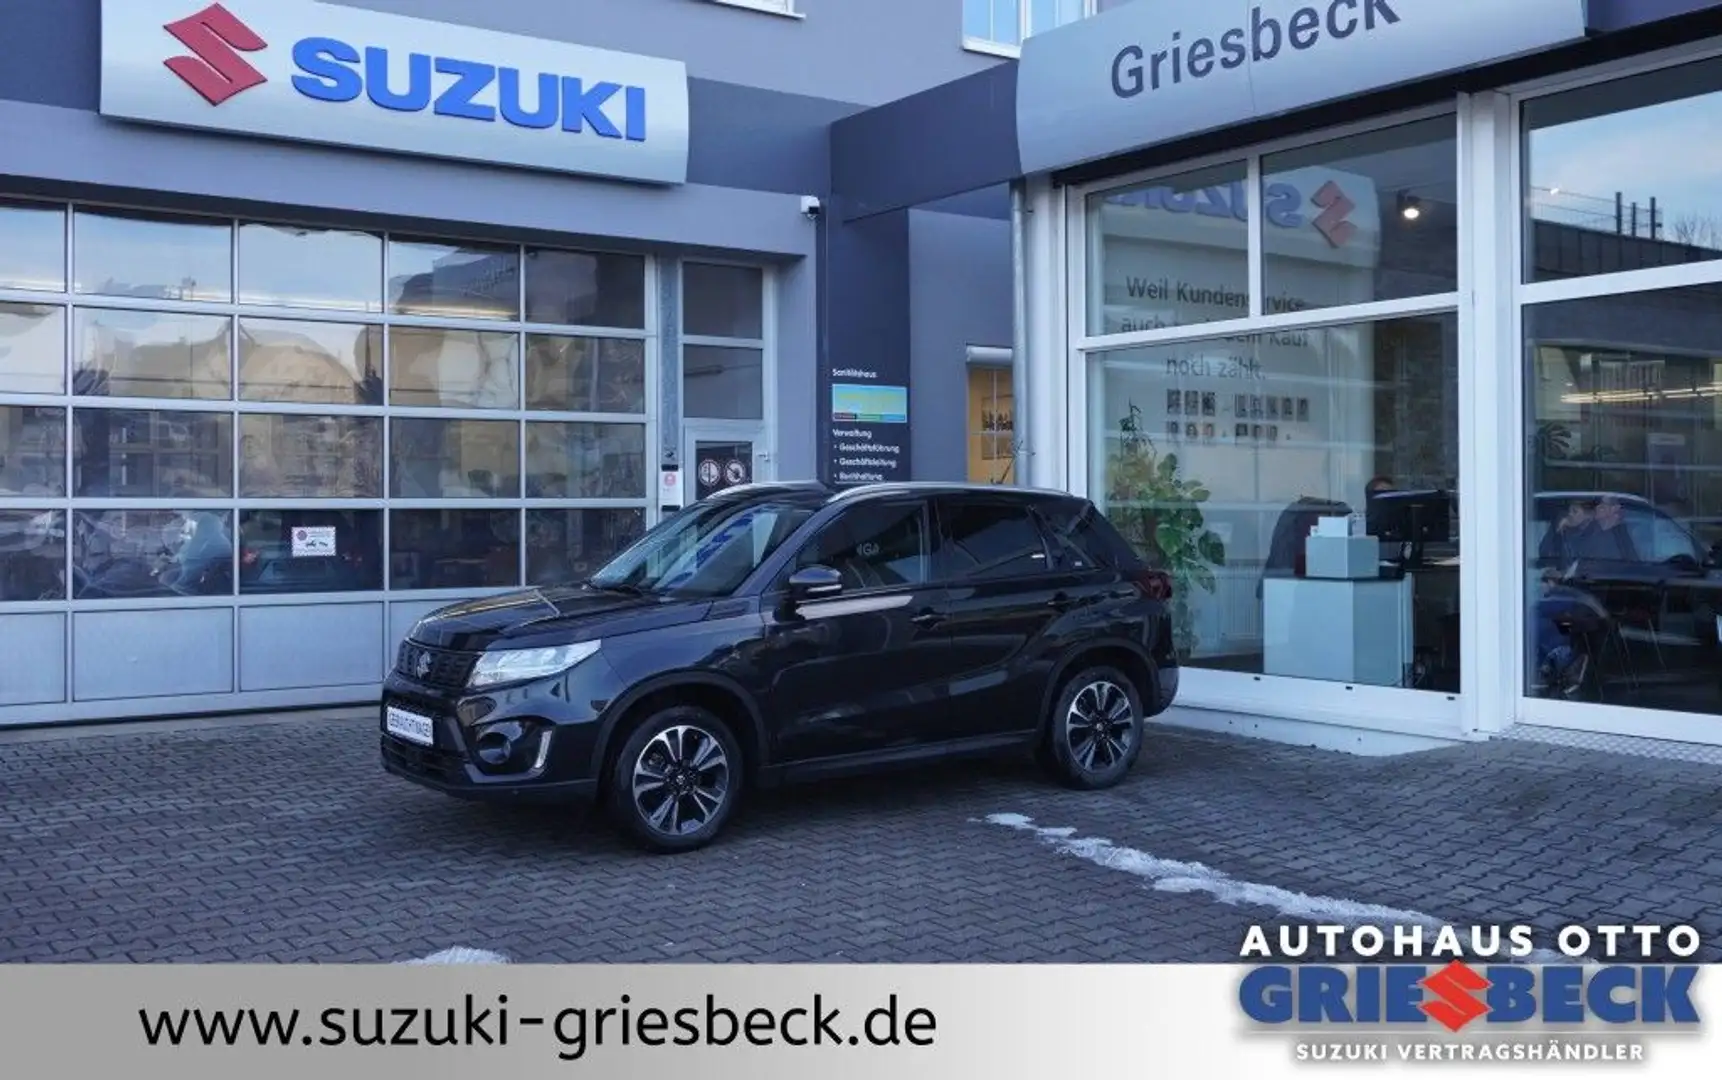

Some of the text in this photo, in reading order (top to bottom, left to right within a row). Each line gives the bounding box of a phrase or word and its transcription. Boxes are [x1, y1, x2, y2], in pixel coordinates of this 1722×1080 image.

[1111, 0, 1401, 99] Griesbeck
[291, 36, 646, 142] SUZUKI
[1126, 276, 1168, 300] Weil
[1166, 353, 1211, 376] noch
[832, 428, 873, 440] Verwaltung
